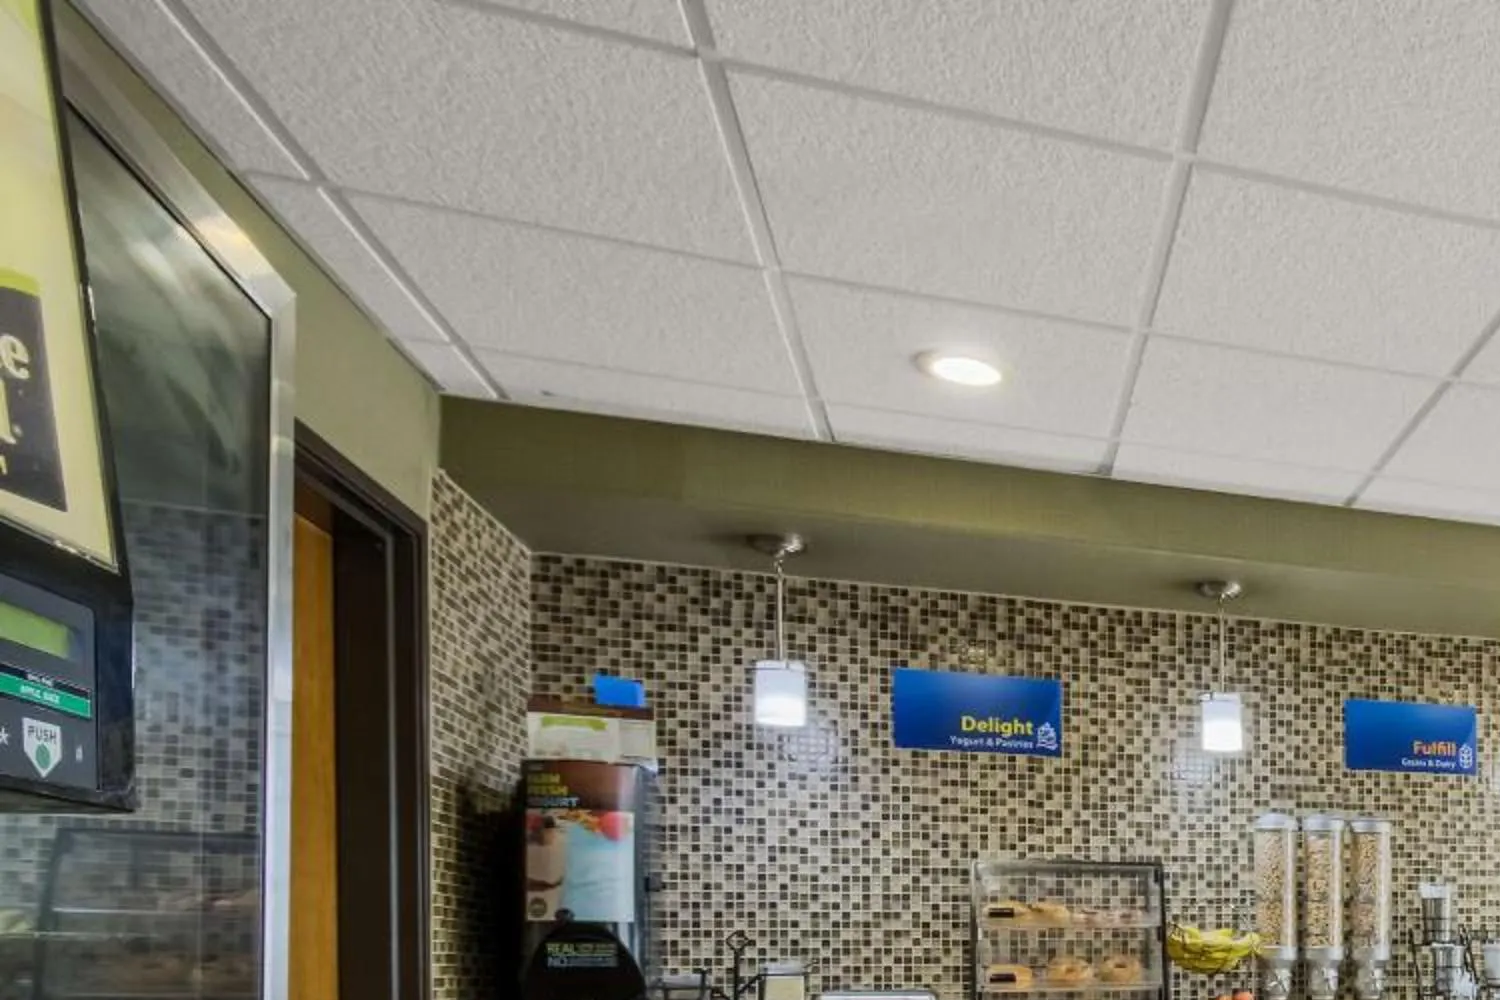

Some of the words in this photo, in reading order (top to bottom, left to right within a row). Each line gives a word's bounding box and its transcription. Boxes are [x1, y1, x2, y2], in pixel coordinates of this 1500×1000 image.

[27, 724, 57, 743] PUSH
[961, 715, 1033, 738] Delight
[1413, 741, 1457, 757] Fulfill
